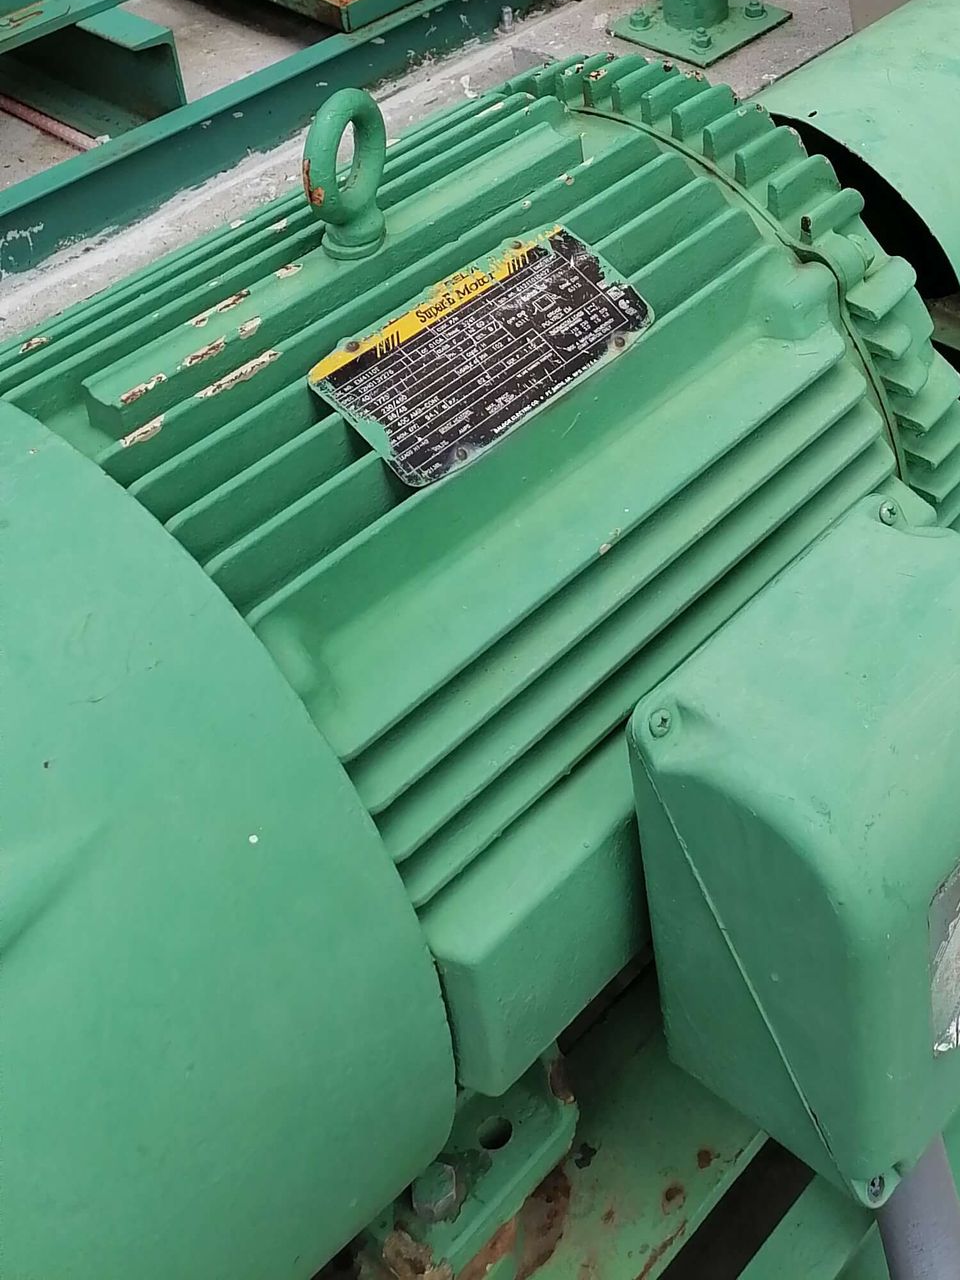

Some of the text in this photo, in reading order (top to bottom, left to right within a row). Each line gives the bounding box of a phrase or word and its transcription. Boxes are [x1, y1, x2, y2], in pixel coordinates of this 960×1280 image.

[455, 271, 495, 300] Motor
[353, 366, 380, 385] EM4110T
[395, 416, 410, 427] 40C
[407, 395, 441, 418] AMB-CONT
